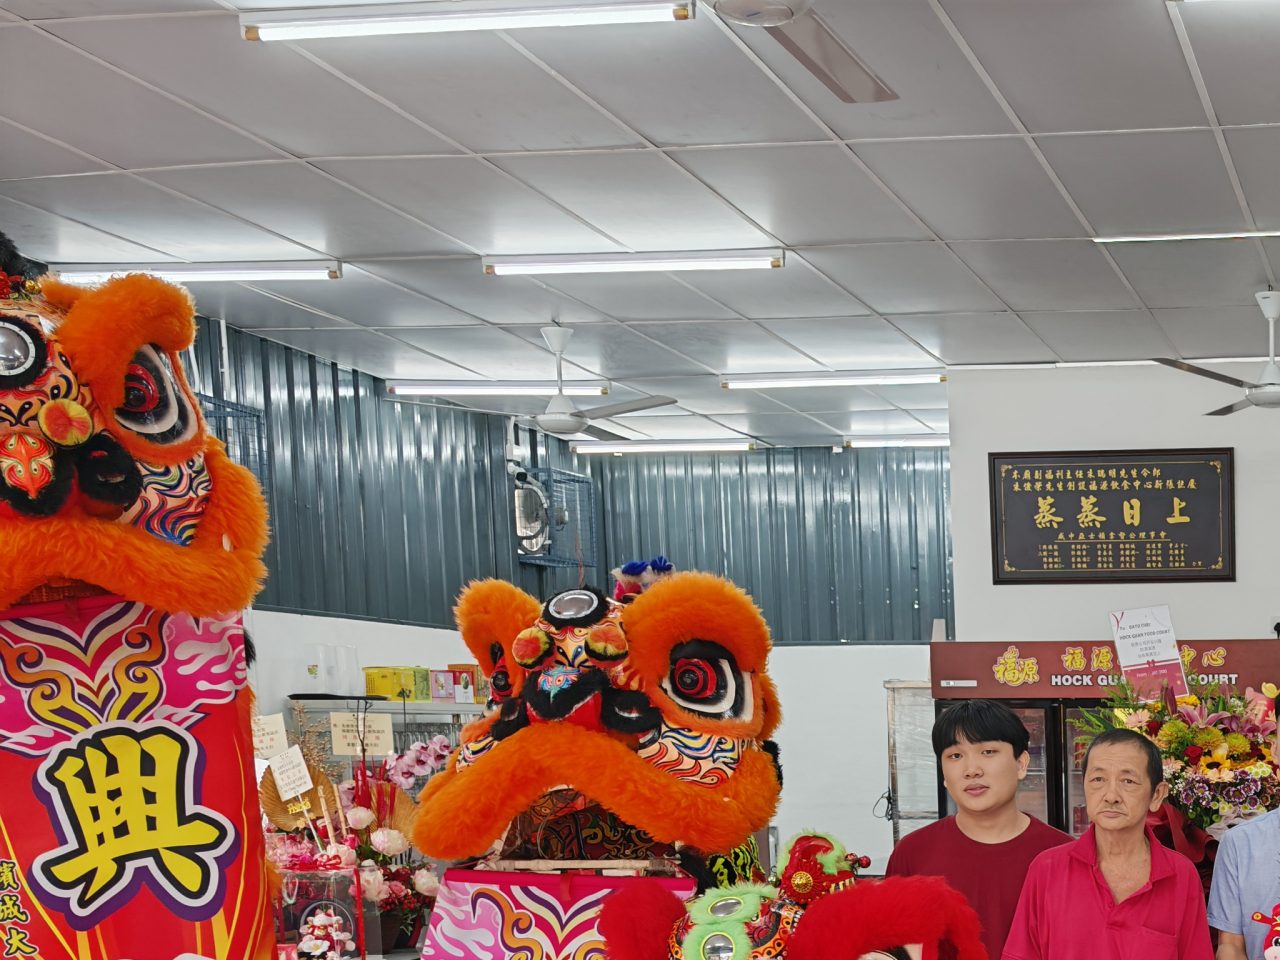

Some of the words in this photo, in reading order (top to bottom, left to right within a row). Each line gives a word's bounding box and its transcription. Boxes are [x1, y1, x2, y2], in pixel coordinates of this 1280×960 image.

[1034, 495, 1190, 528] 蒸蒸日上
[993, 646, 1039, 686] 福源
[1051, 675, 1093, 685] HOCK
